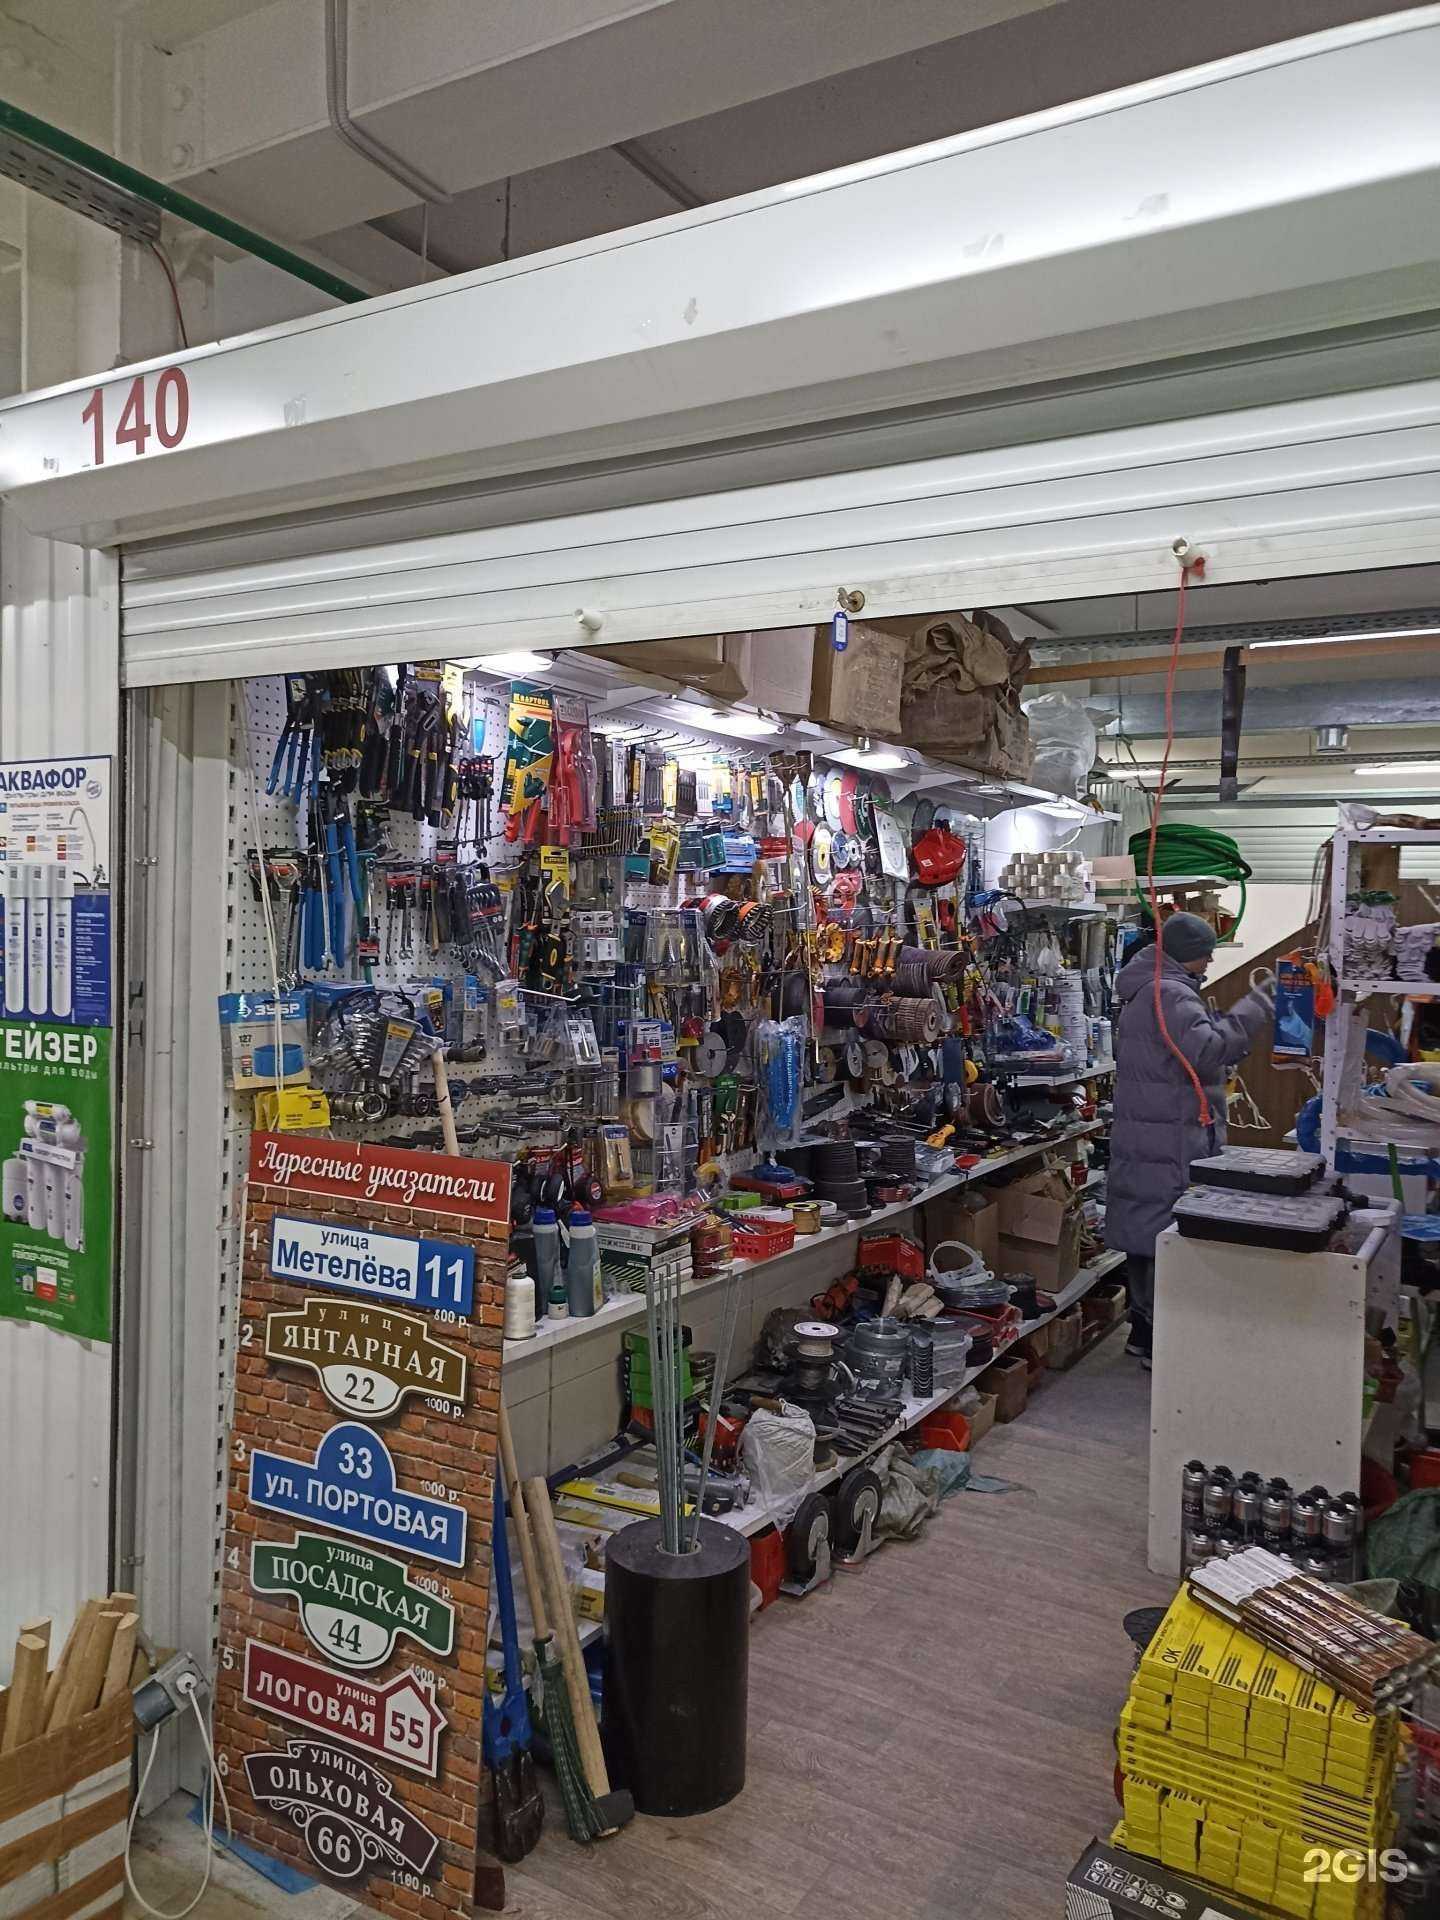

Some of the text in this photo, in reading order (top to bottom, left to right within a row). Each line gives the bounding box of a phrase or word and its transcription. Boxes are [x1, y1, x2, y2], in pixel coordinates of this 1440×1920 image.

[82, 366, 189, 465] 140
[0, 767, 87, 792] АКВАФОР
[258, 1141, 496, 1203] Адресные указатели
[321, 1229, 369, 1251] улица
[277, 1238, 412, 1292] Метелёва
[424, 1254, 464, 1303] 11
[241, 1324, 253, 1347] 2
[318, 1307, 412, 1337] улица
[282, 1325, 448, 1384] ЯНТАРНАЯ
[344, 1372, 375, 1404] 22
[424, 1397, 450, 1414] 1000
[234, 1439, 246, 1462] 3
[338, 1443, 373, 1479] 33
[420, 1479, 445, 1498] 1000
[265, 1472, 448, 1544] ул. ПОРТОВАЯ
[227, 1546, 240, 1569] 4
[326, 1544, 374, 1571] улица
[271, 1555, 431, 1630] ПОСАДСКАЯ
[328, 1618, 362, 1654] 44
[222, 1647, 234, 1671] 5
[256, 1671, 376, 1737] ЛОГОВАЯ
[336, 1682, 377, 1706] улица
[389, 1712, 424, 1749] 55
[217, 1754, 229, 1776] 6
[310, 1748, 369, 1786] УЛИЦА
[269, 1766, 406, 1843] ОЛЬХОВАЯ
[317, 1825, 352, 1863] 66
